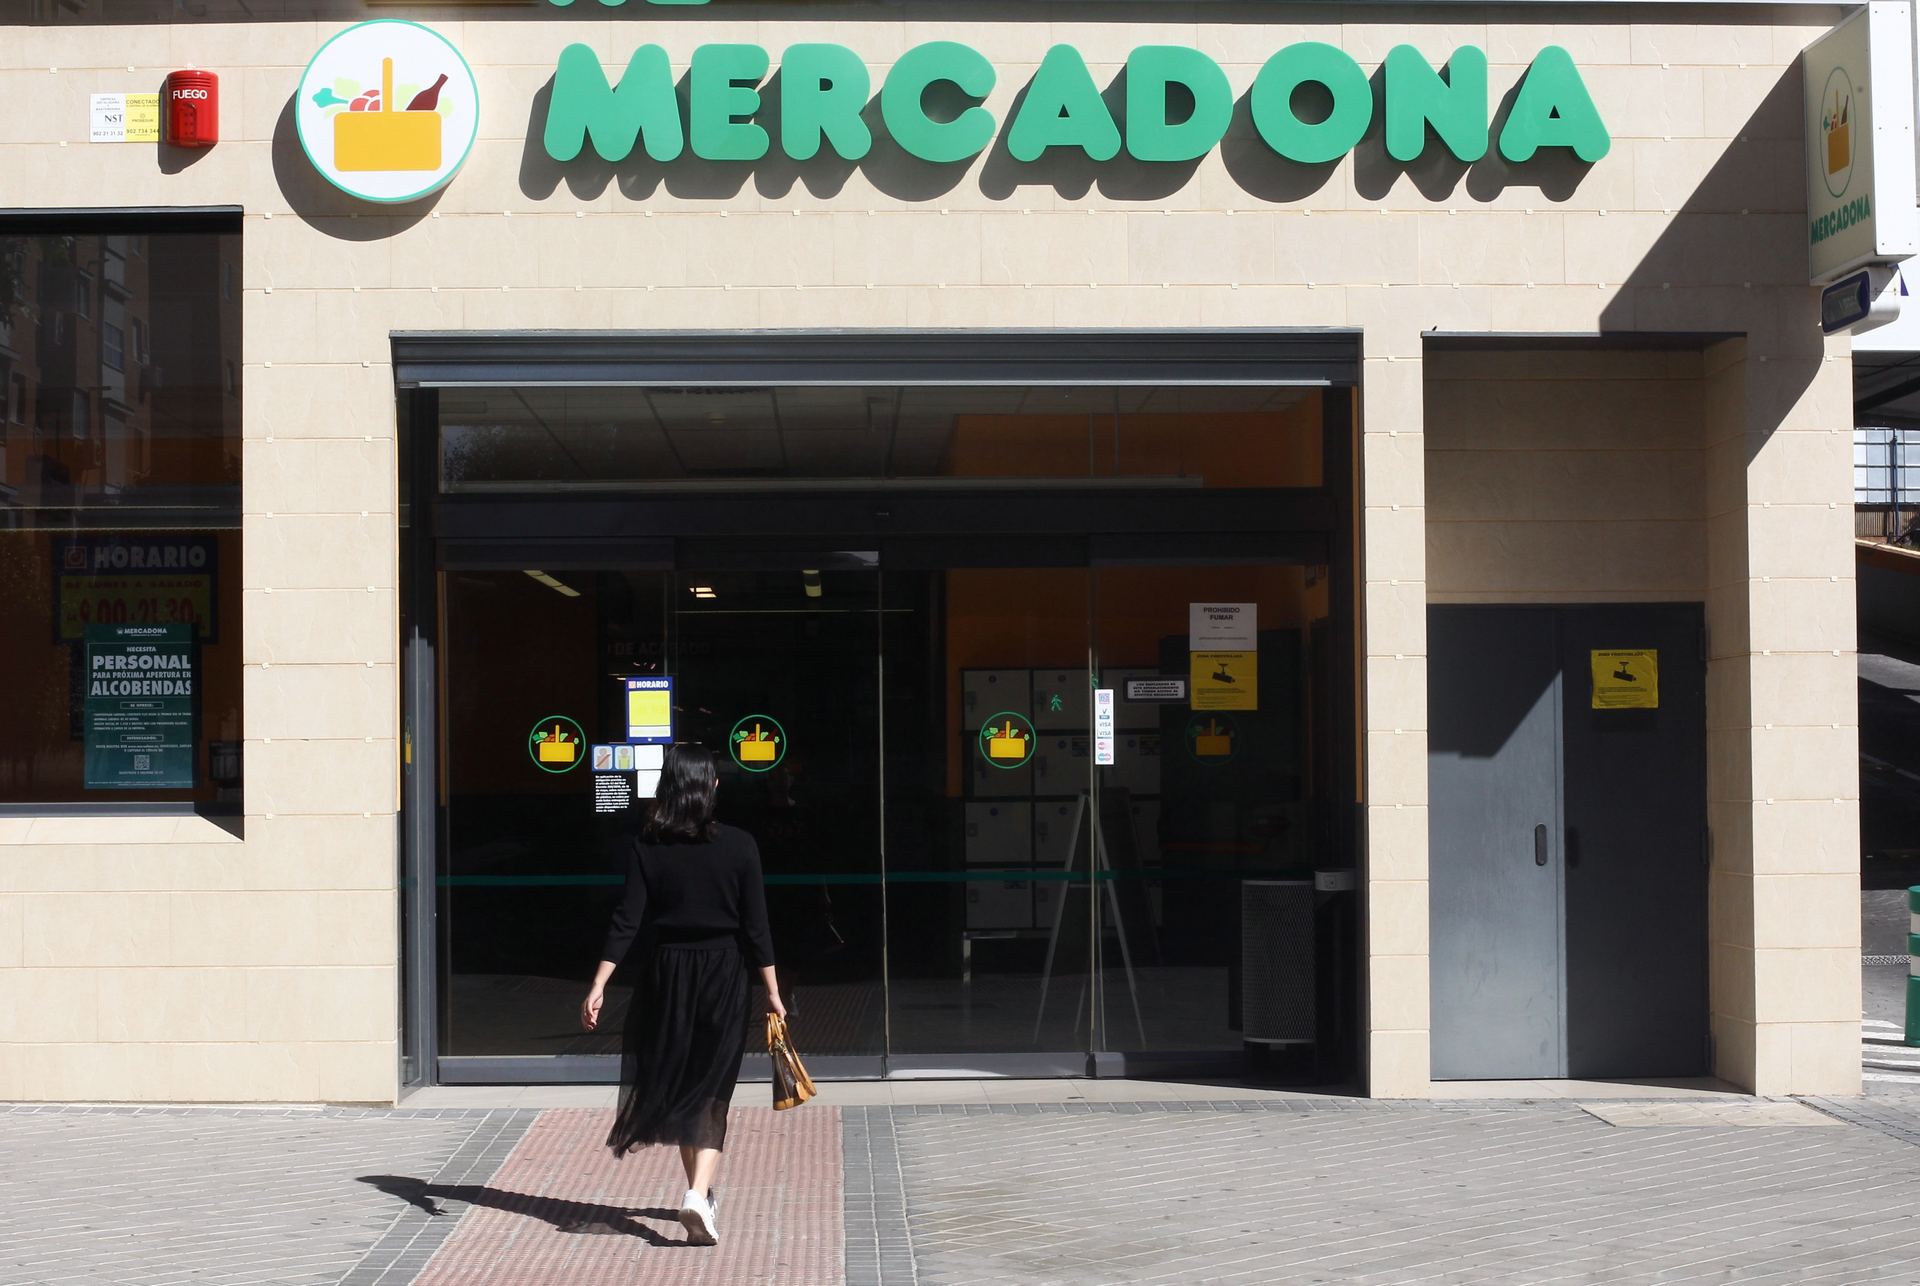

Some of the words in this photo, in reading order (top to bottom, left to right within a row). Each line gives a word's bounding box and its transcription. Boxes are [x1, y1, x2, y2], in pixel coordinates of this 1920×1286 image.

[172, 89, 208, 100] FUEGO
[544, 41, 1611, 163] MERCADONA
[104, 114, 123, 123] NST
[1810, 194, 1871, 246] MERCADONA
[95, 546, 206, 568] HORARIO
[1203, 606, 1241, 614] PROHIBIDO
[92, 655, 192, 670] PERSONAL
[112, 670, 144, 679] PRÓXIMA
[91, 680, 192, 696] ALCOBENDAS
[636, 680, 669, 689] HORARIO
